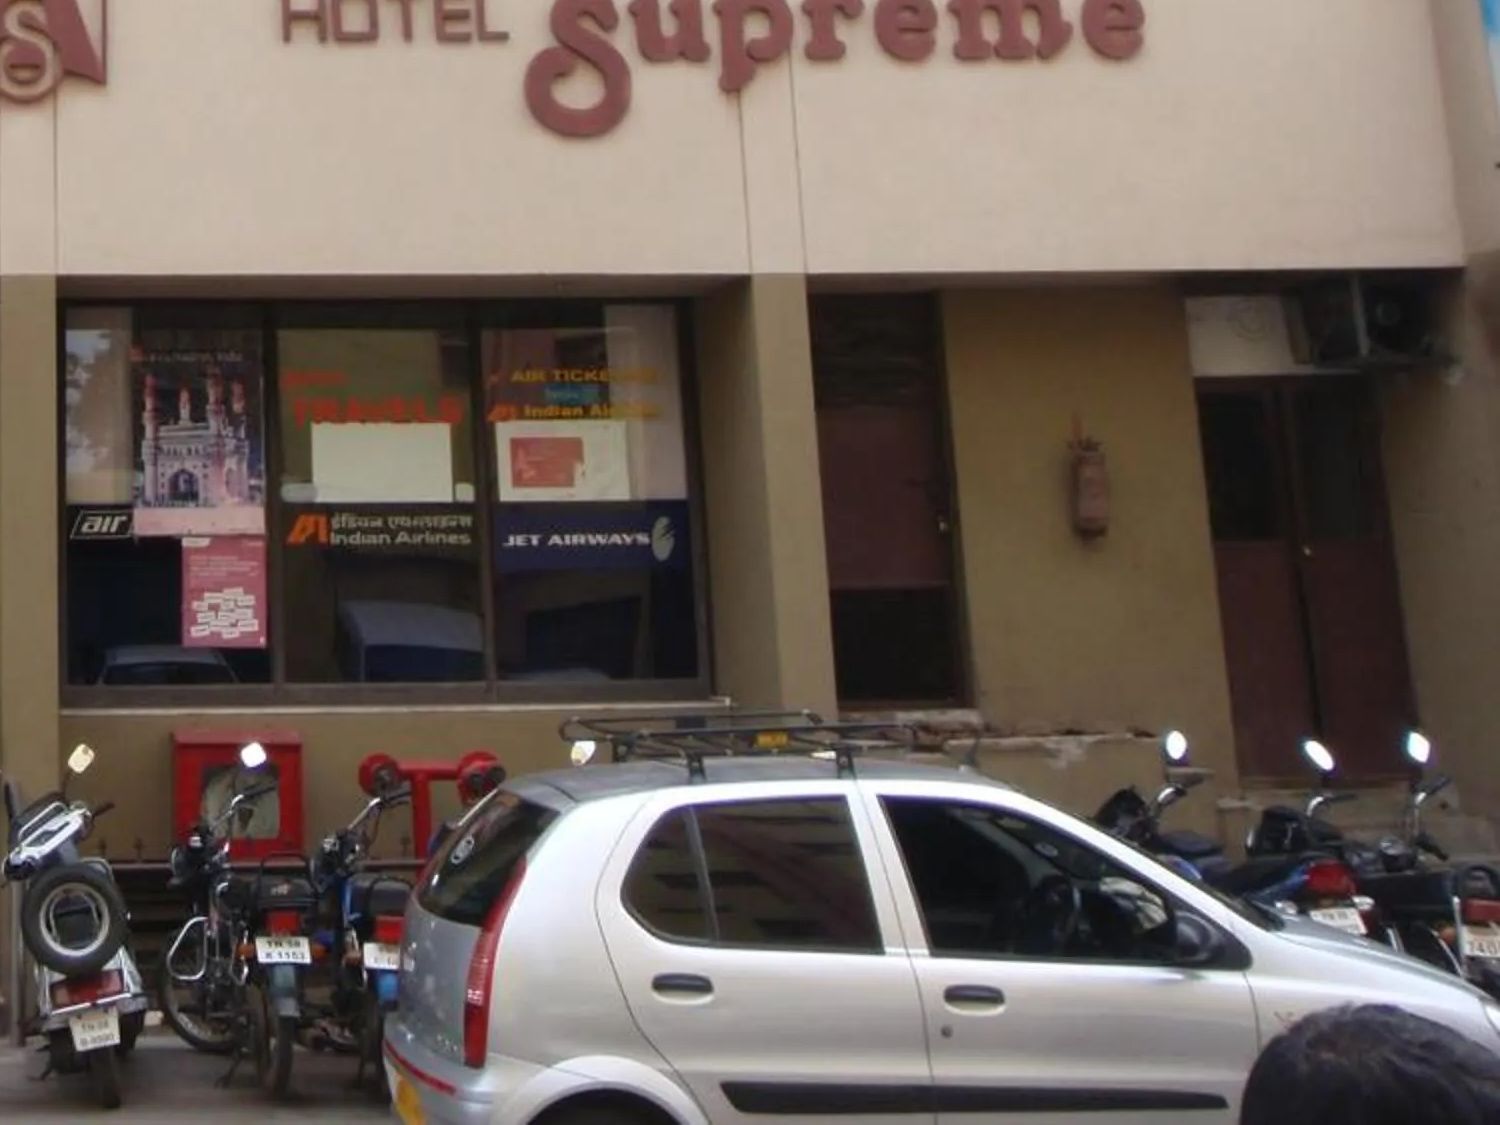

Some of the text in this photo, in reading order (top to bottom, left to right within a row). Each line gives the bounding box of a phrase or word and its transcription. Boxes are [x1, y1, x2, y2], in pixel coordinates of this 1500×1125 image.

[81, 515, 128, 534] air
[331, 531, 472, 546] Indian Airlines
[502, 532, 651, 547] JET AIRWAYS
